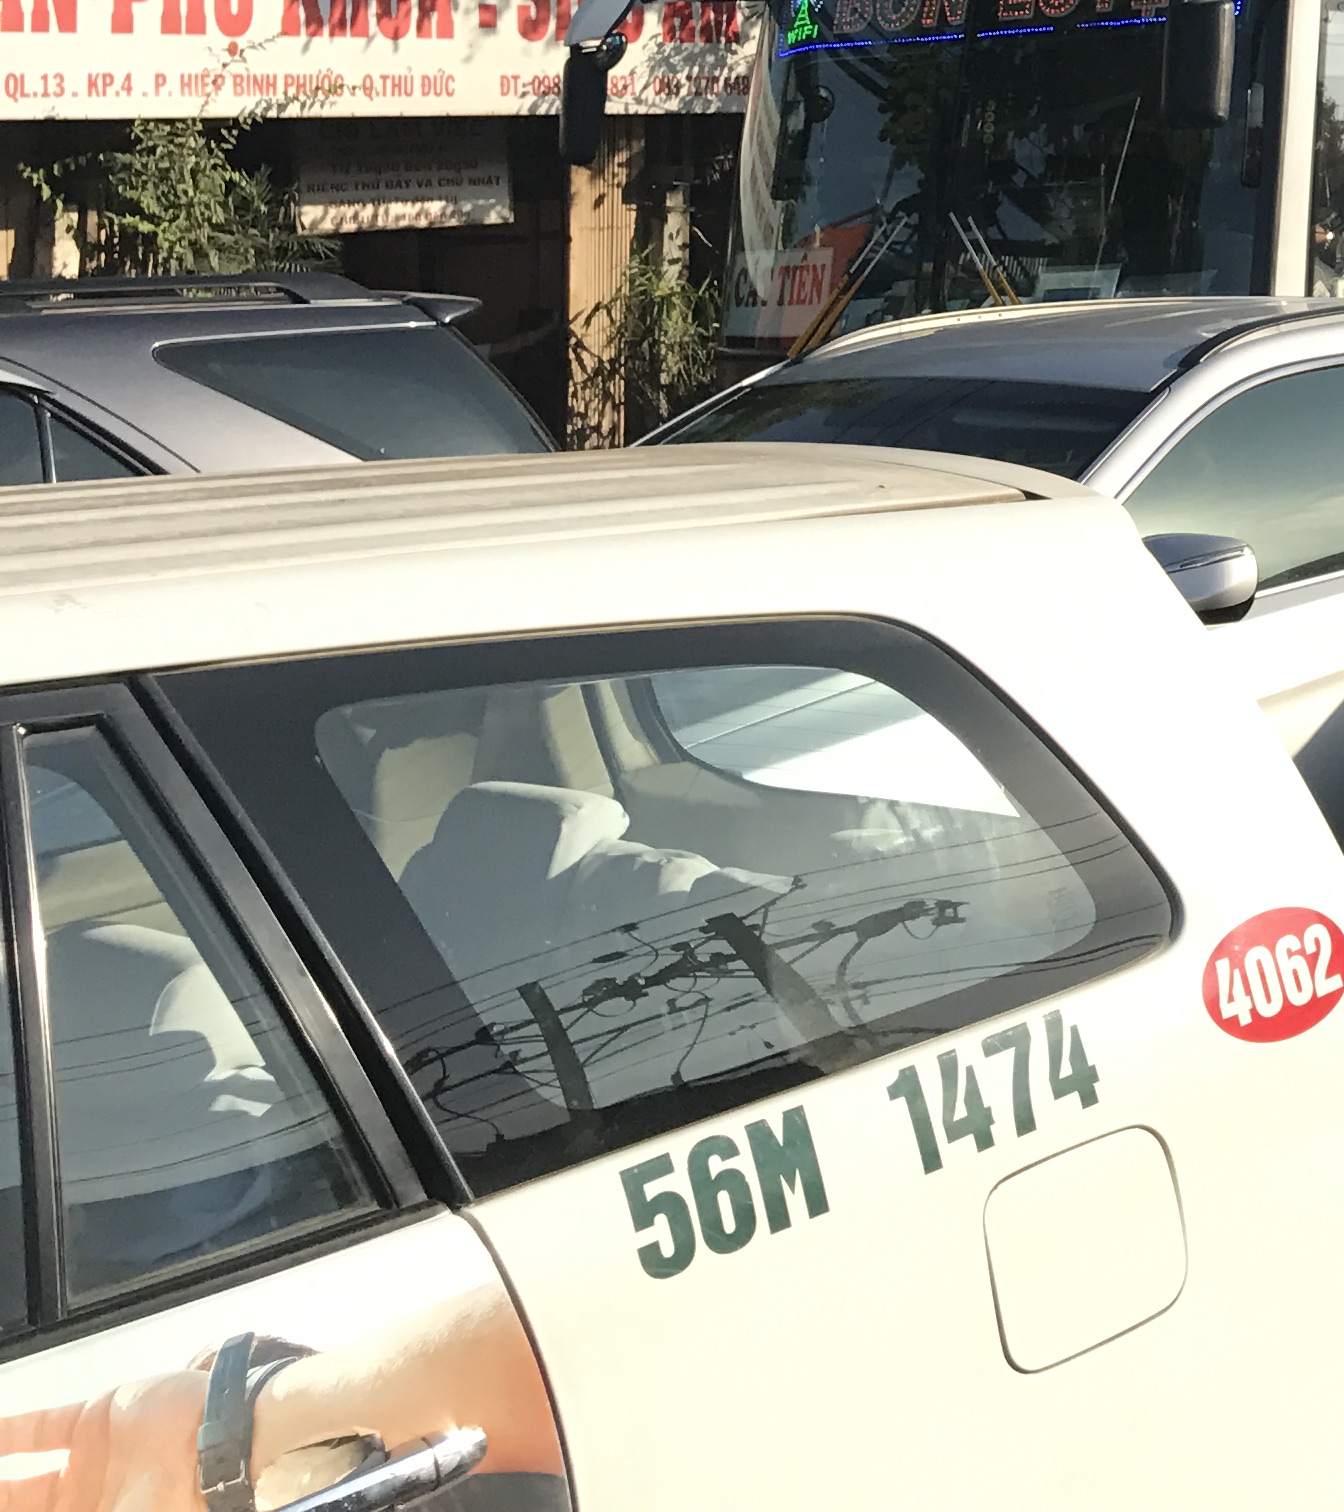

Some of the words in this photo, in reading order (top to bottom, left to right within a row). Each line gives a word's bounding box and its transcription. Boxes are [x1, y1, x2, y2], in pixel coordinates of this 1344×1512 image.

[787, 24, 819, 46] WIFI
[4, 72, 66, 102] QL.13
[87, 72, 133, 98] KP.4
[421, 67, 456, 98] ĐỨC
[1215, 923, 1344, 1028] 4062
[619, 1104, 830, 1280] 56M
[886, 1009, 1100, 1176] 1474
